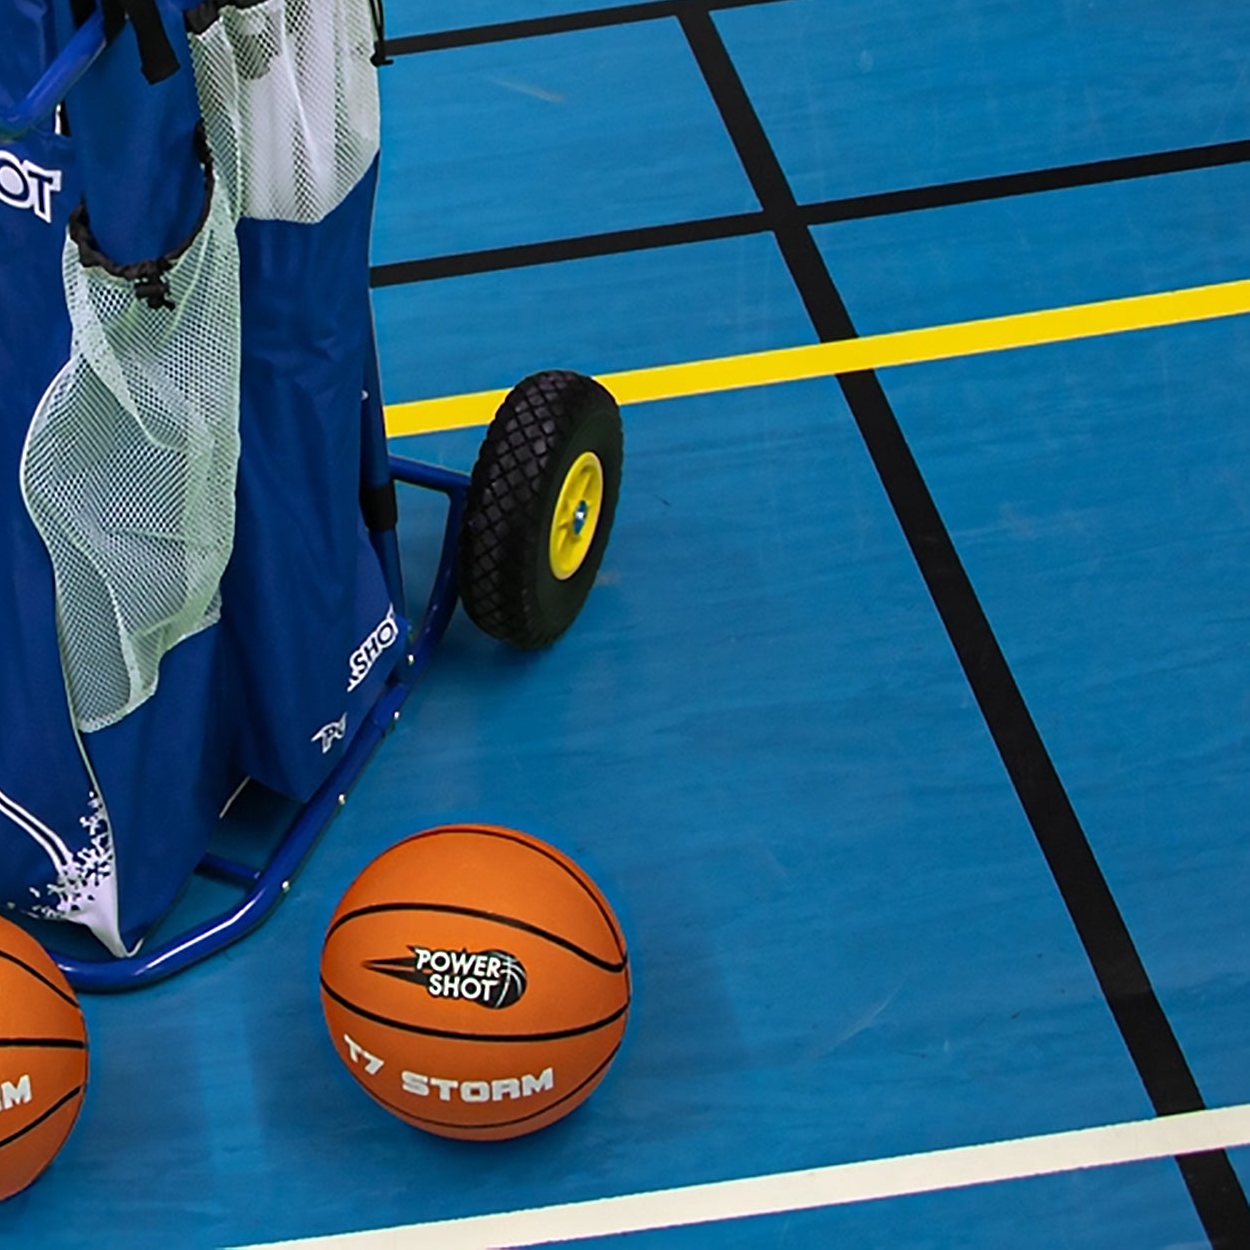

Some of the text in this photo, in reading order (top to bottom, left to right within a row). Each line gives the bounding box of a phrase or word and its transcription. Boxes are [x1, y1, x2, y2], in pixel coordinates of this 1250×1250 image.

[415, 948, 501, 977] POWER
[429, 974, 499, 1001] SHOT
[400, 1066, 555, 1103] STORM
